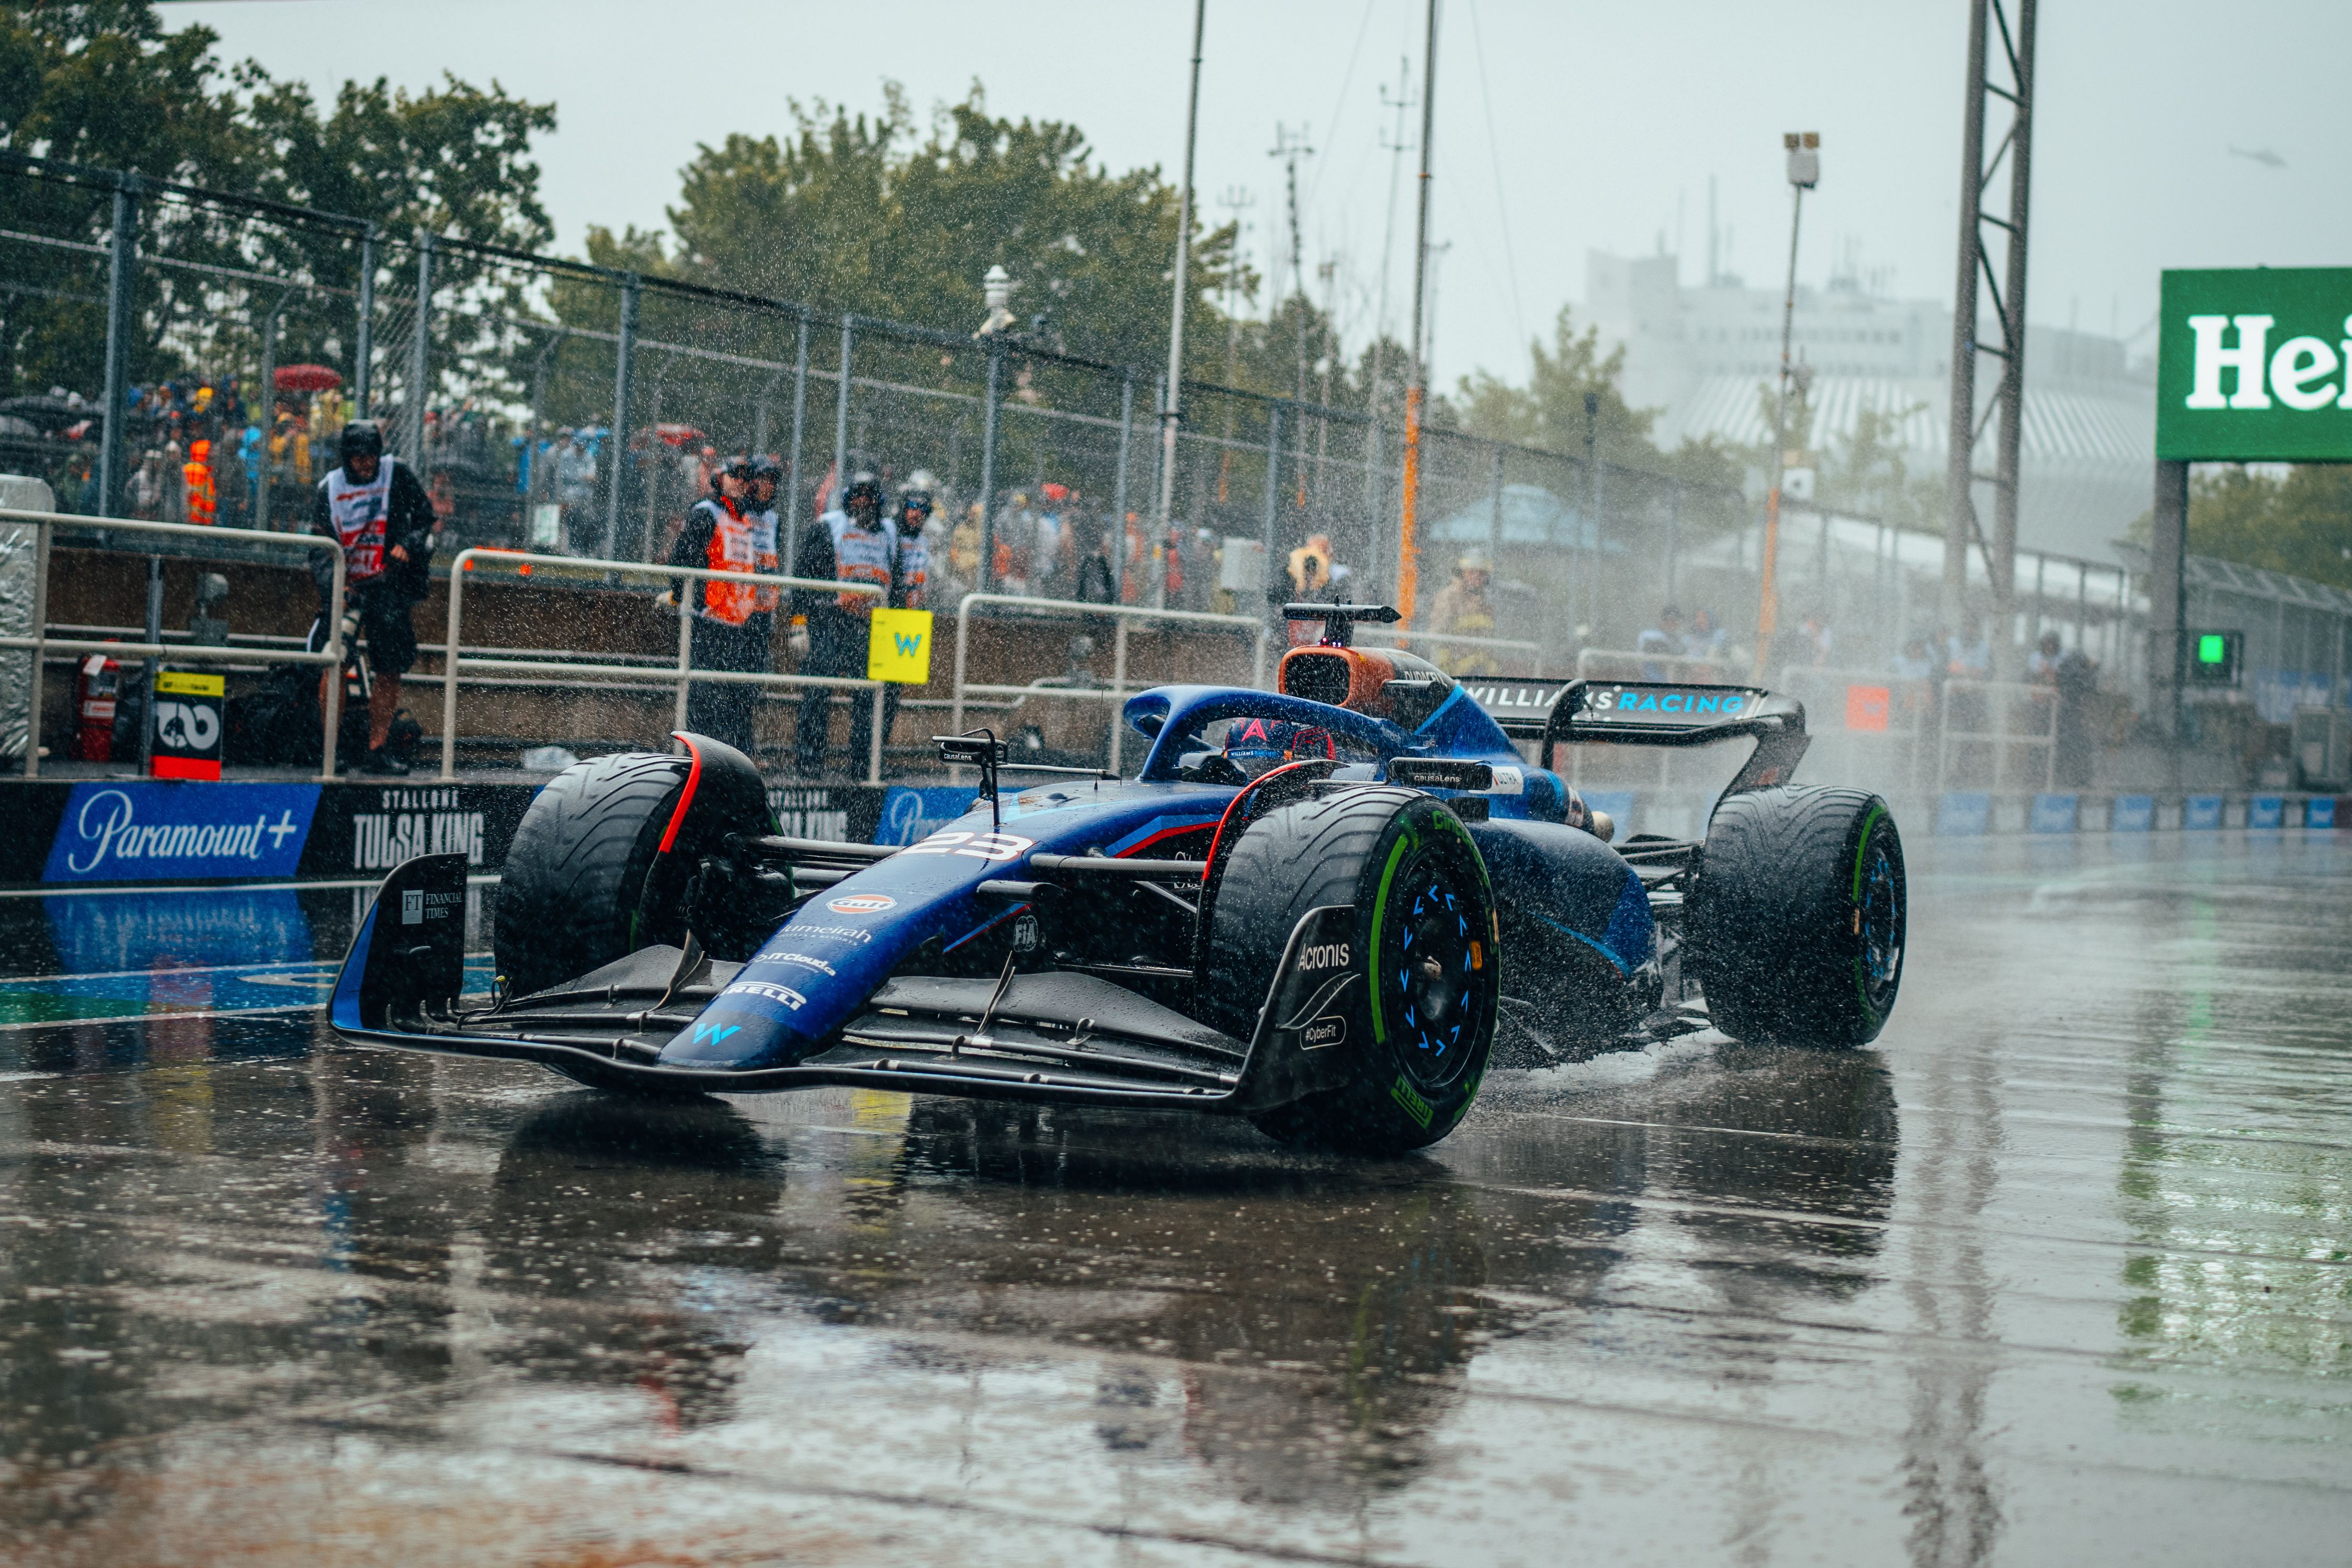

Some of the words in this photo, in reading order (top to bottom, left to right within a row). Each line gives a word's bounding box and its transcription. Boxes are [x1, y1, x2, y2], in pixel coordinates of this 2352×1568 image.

[895, 633, 921, 657] W
[1618, 692, 1744, 713] RACING
[382, 790, 459, 810] STALLONE
[68, 790, 297, 873] Paramount+
[353, 813, 425, 869] TULSA
[431, 812, 484, 865] KING
[899, 832, 1036, 861] 23
[405, 894, 422, 911] FT
[425, 892, 463, 904] FINANCIAL
[832, 899, 892, 908] Gulf
[425, 907, 449, 919] TIMES
[1014, 924, 1036, 946] FIA
[1297, 942, 1349, 972] Acronis
[692, 1022, 742, 1046] W
[1305, 1025, 1336, 1043] #CyberFit
